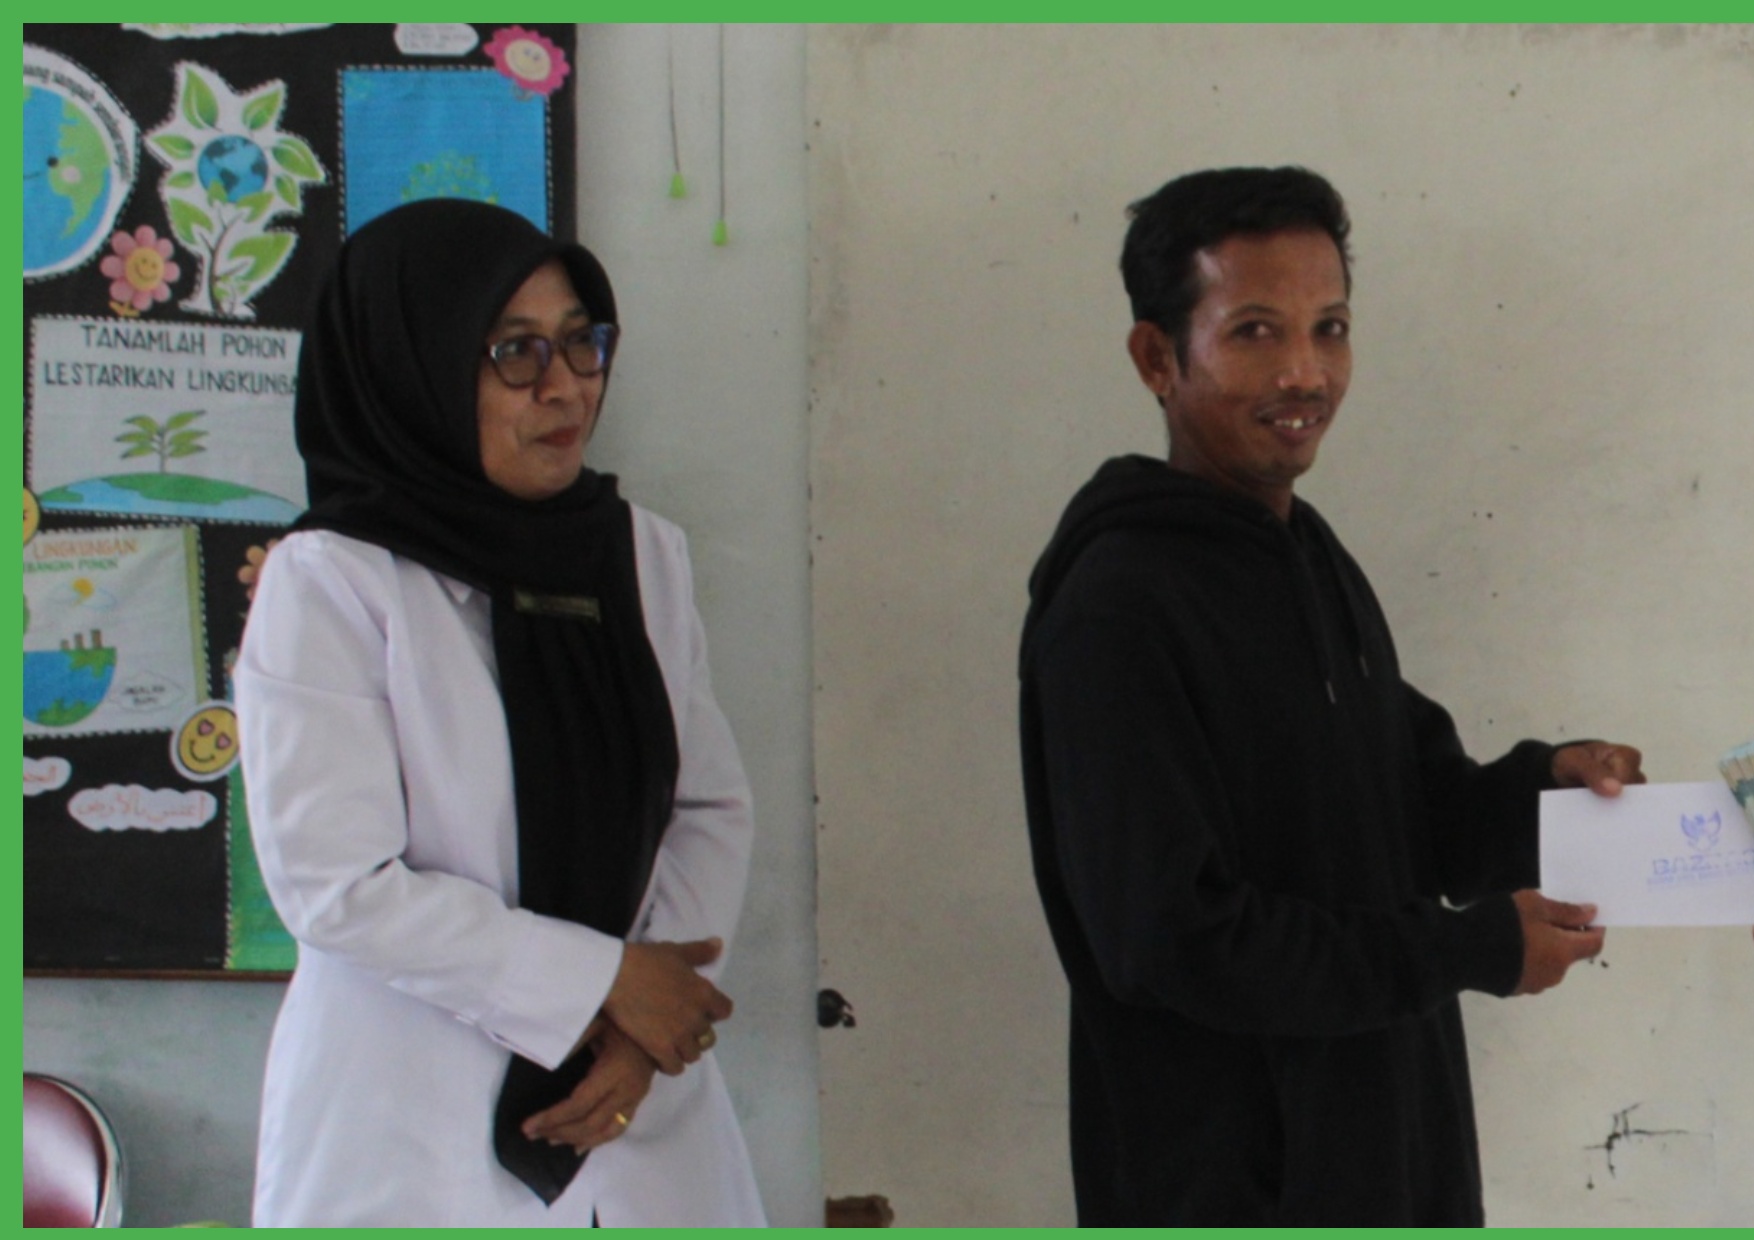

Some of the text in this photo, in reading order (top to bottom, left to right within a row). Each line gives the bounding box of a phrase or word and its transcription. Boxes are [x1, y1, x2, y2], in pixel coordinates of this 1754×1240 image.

[81, 324, 287, 358] TANAMLAH POHON
[44, 361, 175, 389] LESTARIKAN
